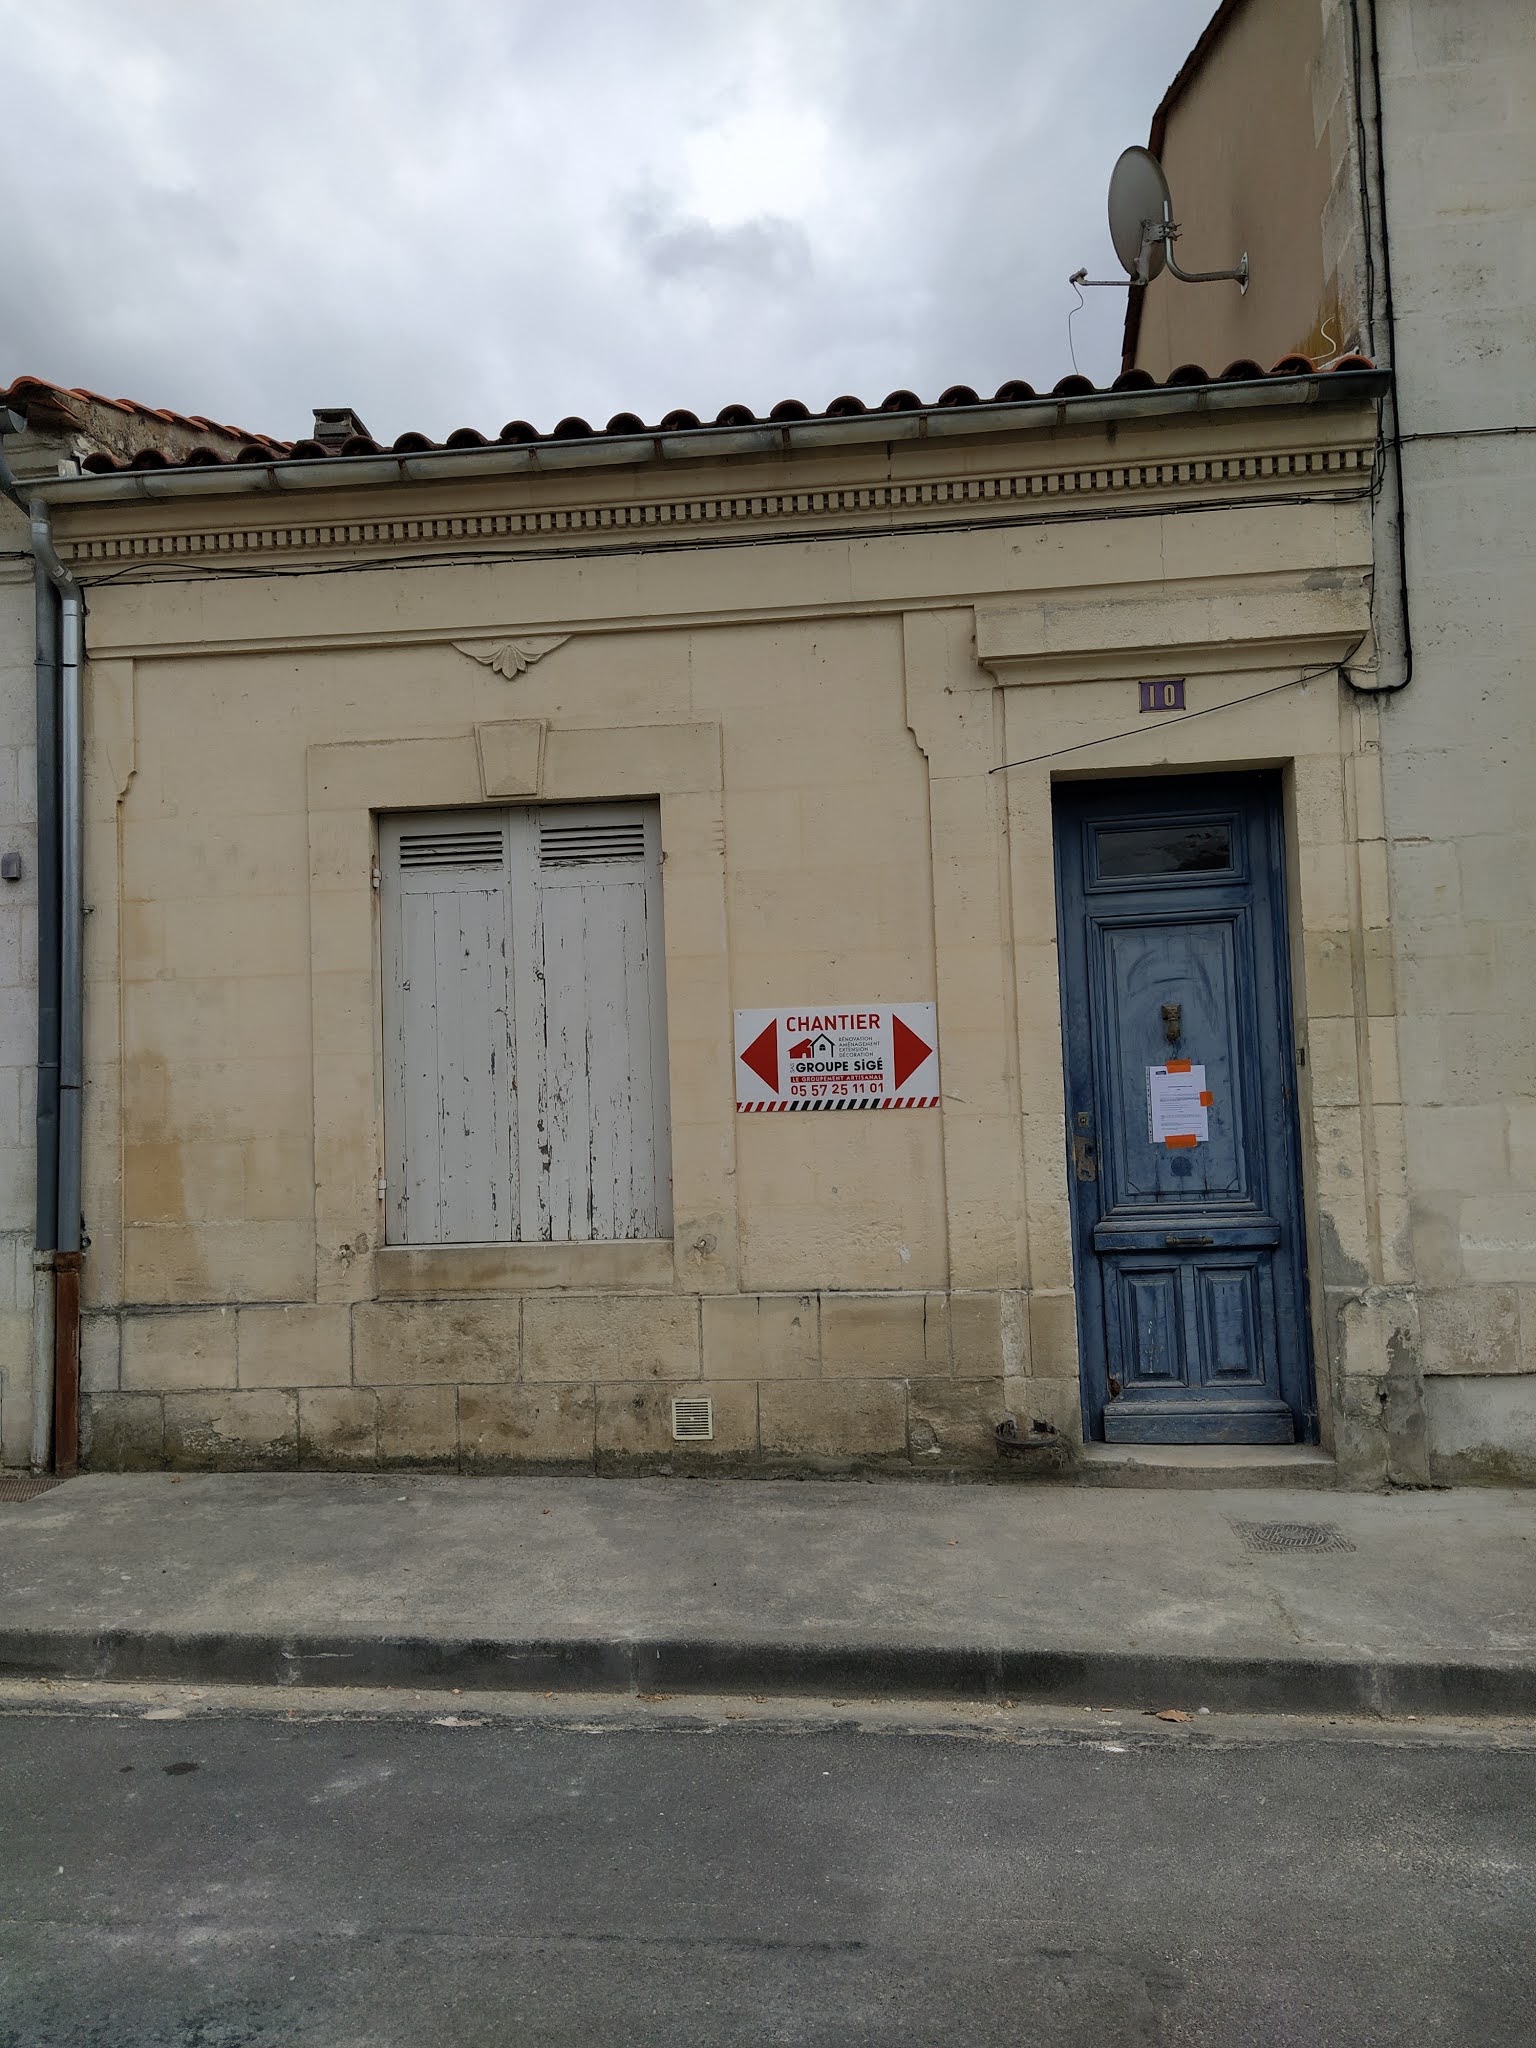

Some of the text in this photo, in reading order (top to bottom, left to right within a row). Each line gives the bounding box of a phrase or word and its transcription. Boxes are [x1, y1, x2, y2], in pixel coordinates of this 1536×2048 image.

[1149, 684, 1175, 708] 10
[786, 1013, 880, 1031] CHANTIER
[796, 1061, 849, 1073] GROUPE
[791, 1082, 884, 1097] 05 57 25 11 01
